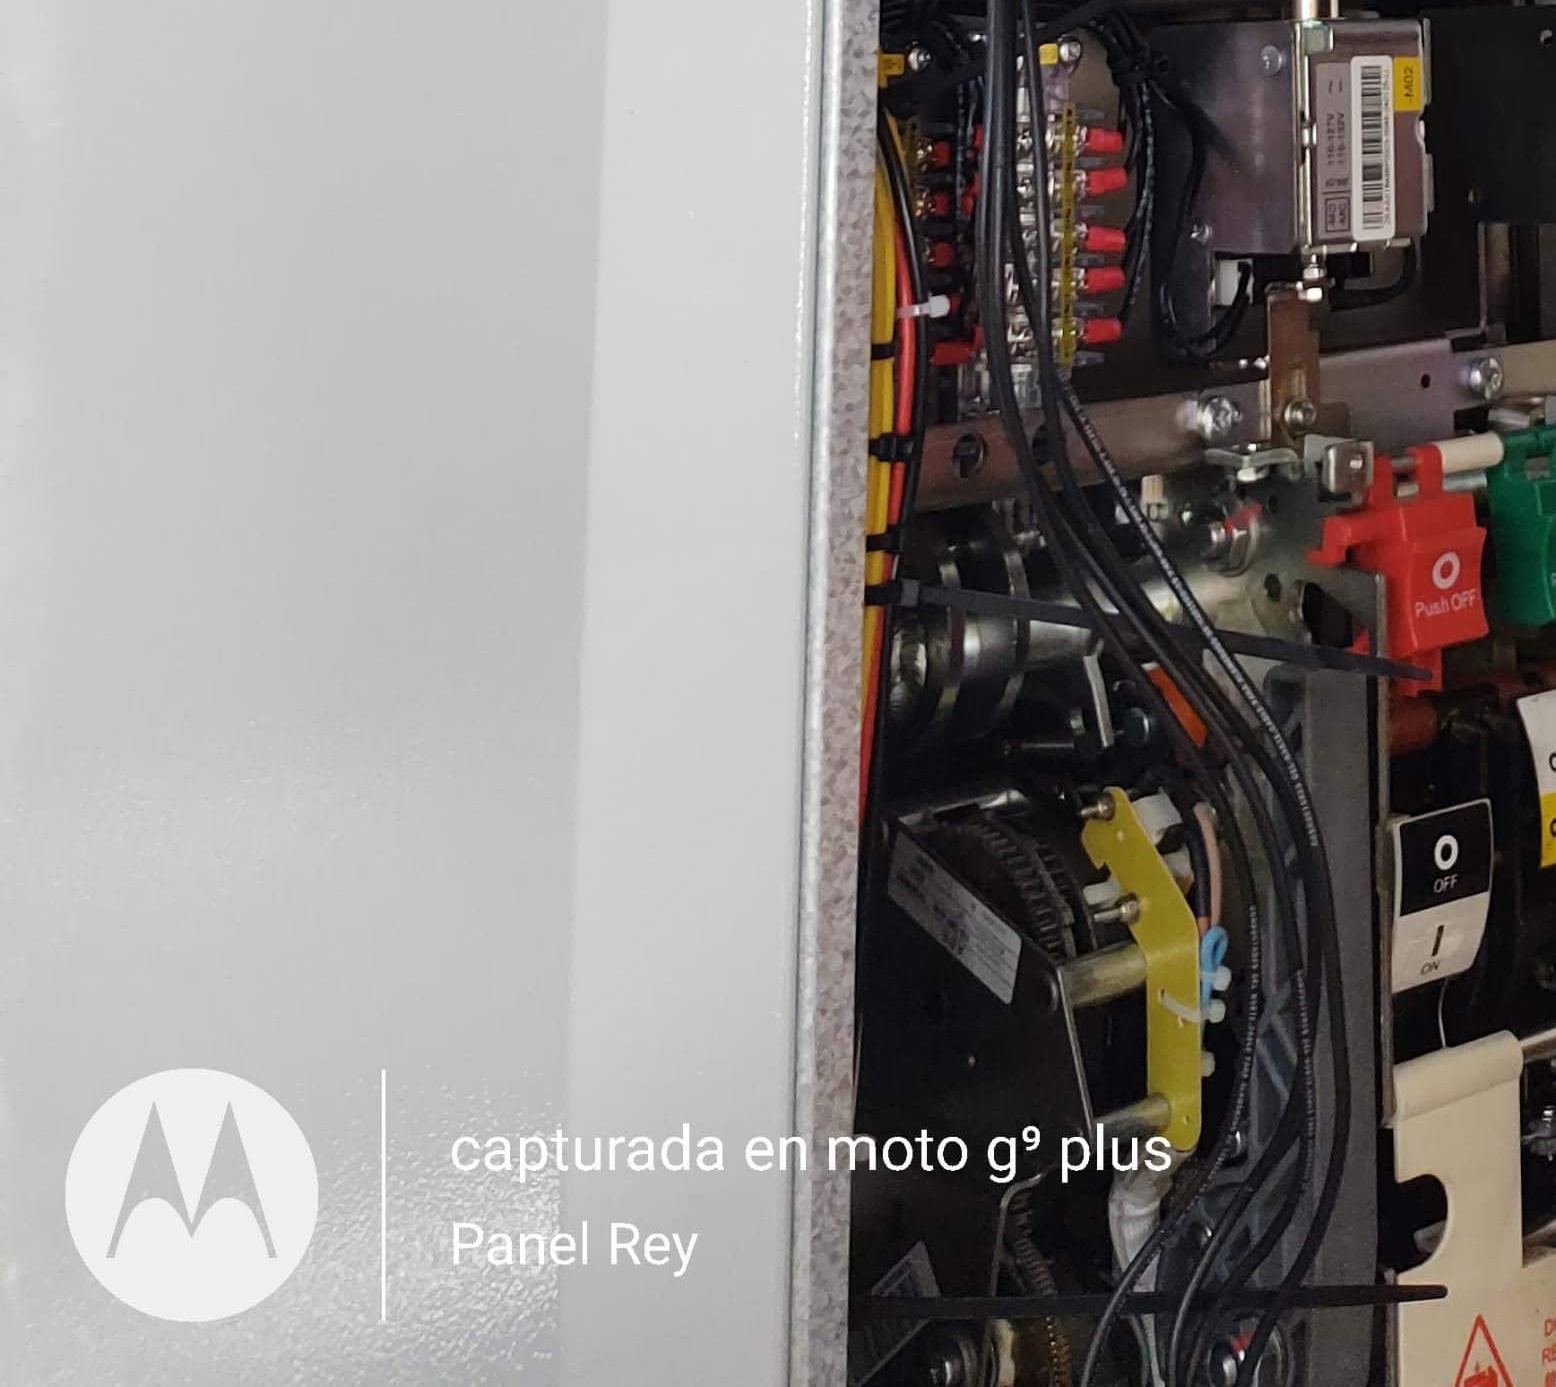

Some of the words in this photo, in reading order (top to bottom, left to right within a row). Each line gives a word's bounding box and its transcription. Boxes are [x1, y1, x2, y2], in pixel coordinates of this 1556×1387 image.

[1415, 596, 1449, 618] Push
[1451, 588, 1476, 610] OFF
[1434, 873, 1459, 894] OFF
[1420, 961, 1441, 976] ON
